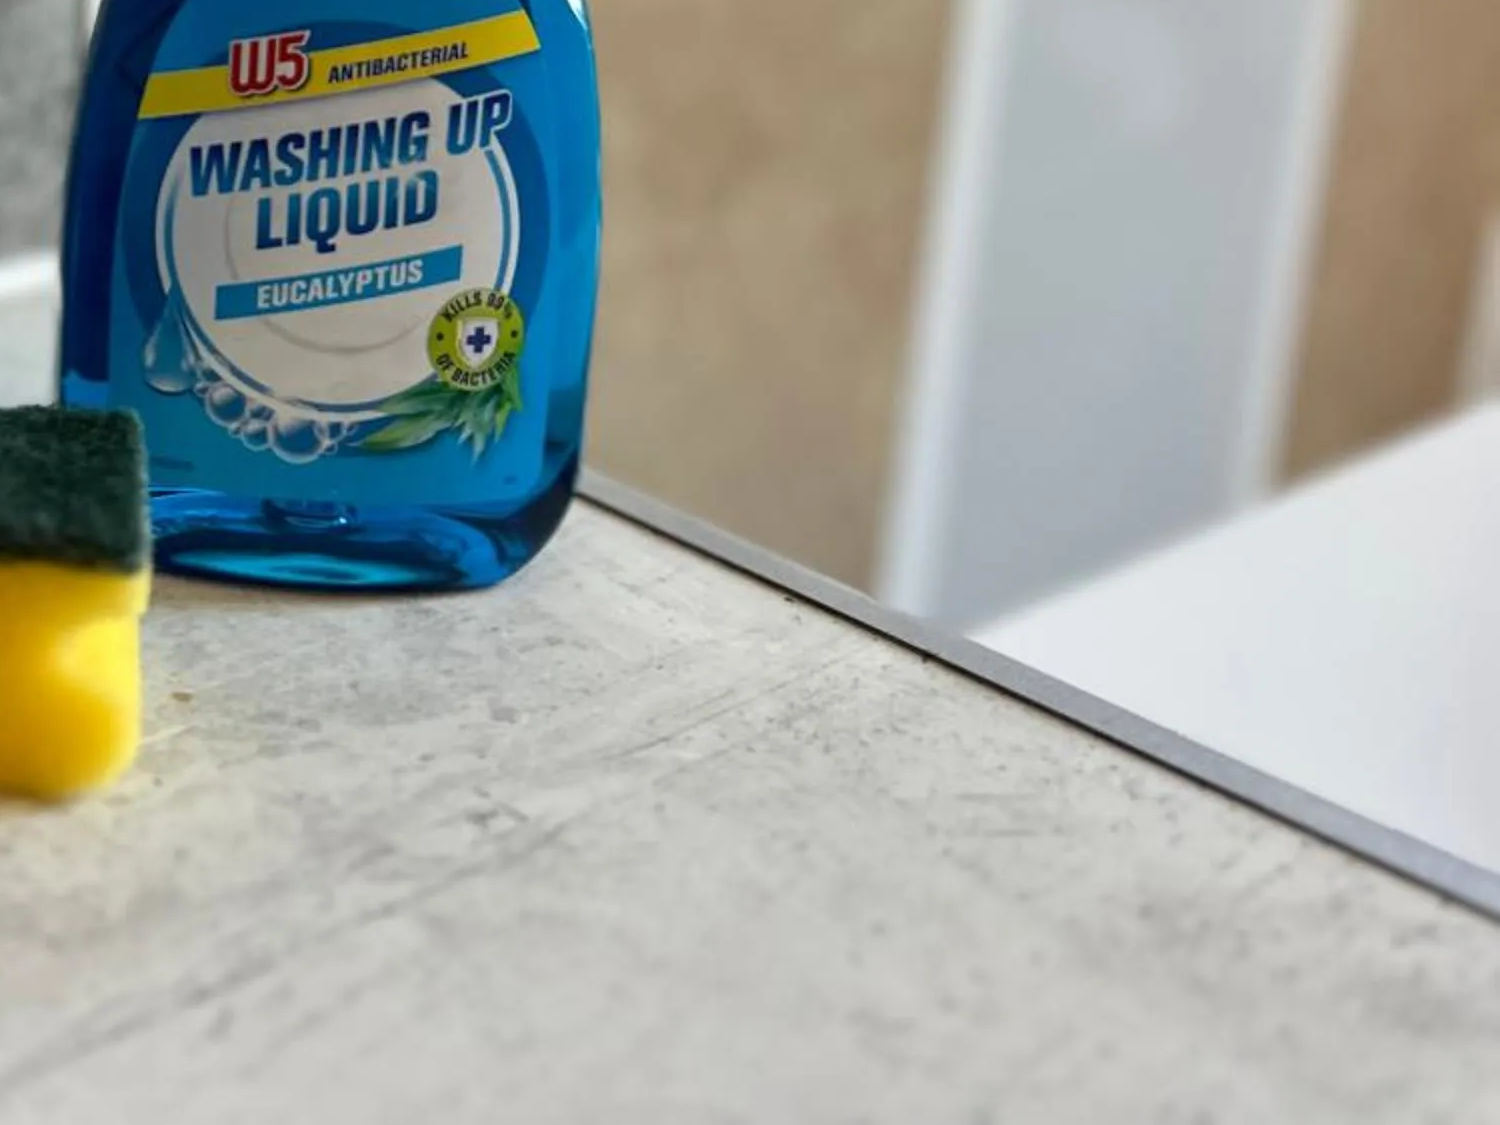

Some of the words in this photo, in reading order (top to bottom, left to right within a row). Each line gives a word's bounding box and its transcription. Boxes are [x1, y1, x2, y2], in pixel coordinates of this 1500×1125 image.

[228, 31, 310, 96] W5
[328, 41, 469, 84] ANTIBACTERIAL
[189, 111, 431, 197] WASHING
[445, 91, 512, 156] UP
[255, 170, 440, 254] LIQUID
[257, 259, 424, 310] EUCALYPTUS
[440, 290, 483, 323] KILLS
[436, 353, 454, 370] OF
[451, 351, 516, 386] BACTERIA
